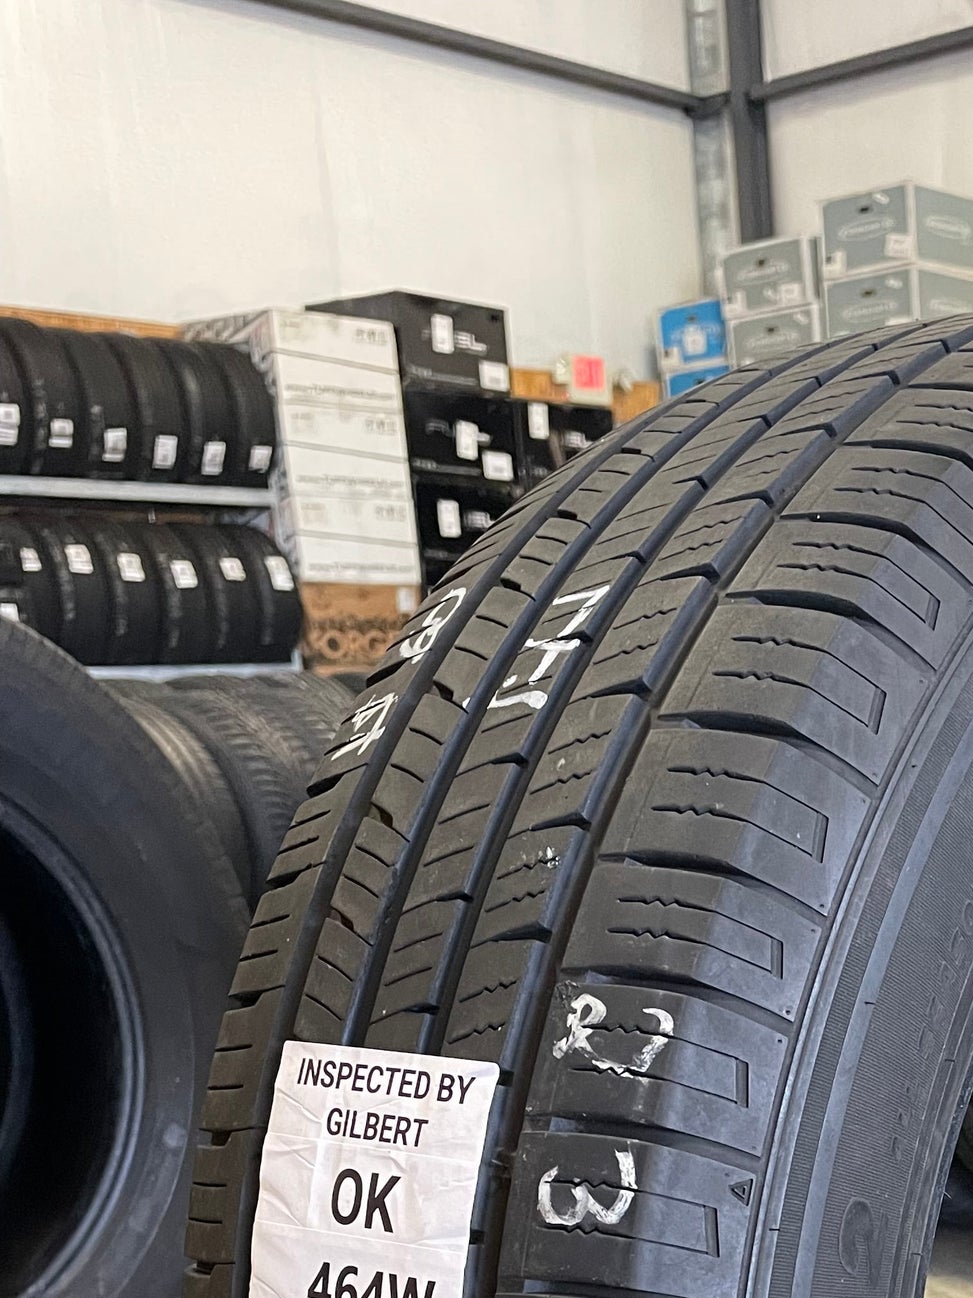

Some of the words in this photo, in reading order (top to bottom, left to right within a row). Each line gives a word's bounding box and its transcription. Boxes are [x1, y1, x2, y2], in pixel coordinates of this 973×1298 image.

[297, 1057, 431, 1100] INSPECTED
[436, 1073, 476, 1105] BY
[325, 1107, 429, 1148] GILBERT
[330, 1167, 402, 1234] OK
